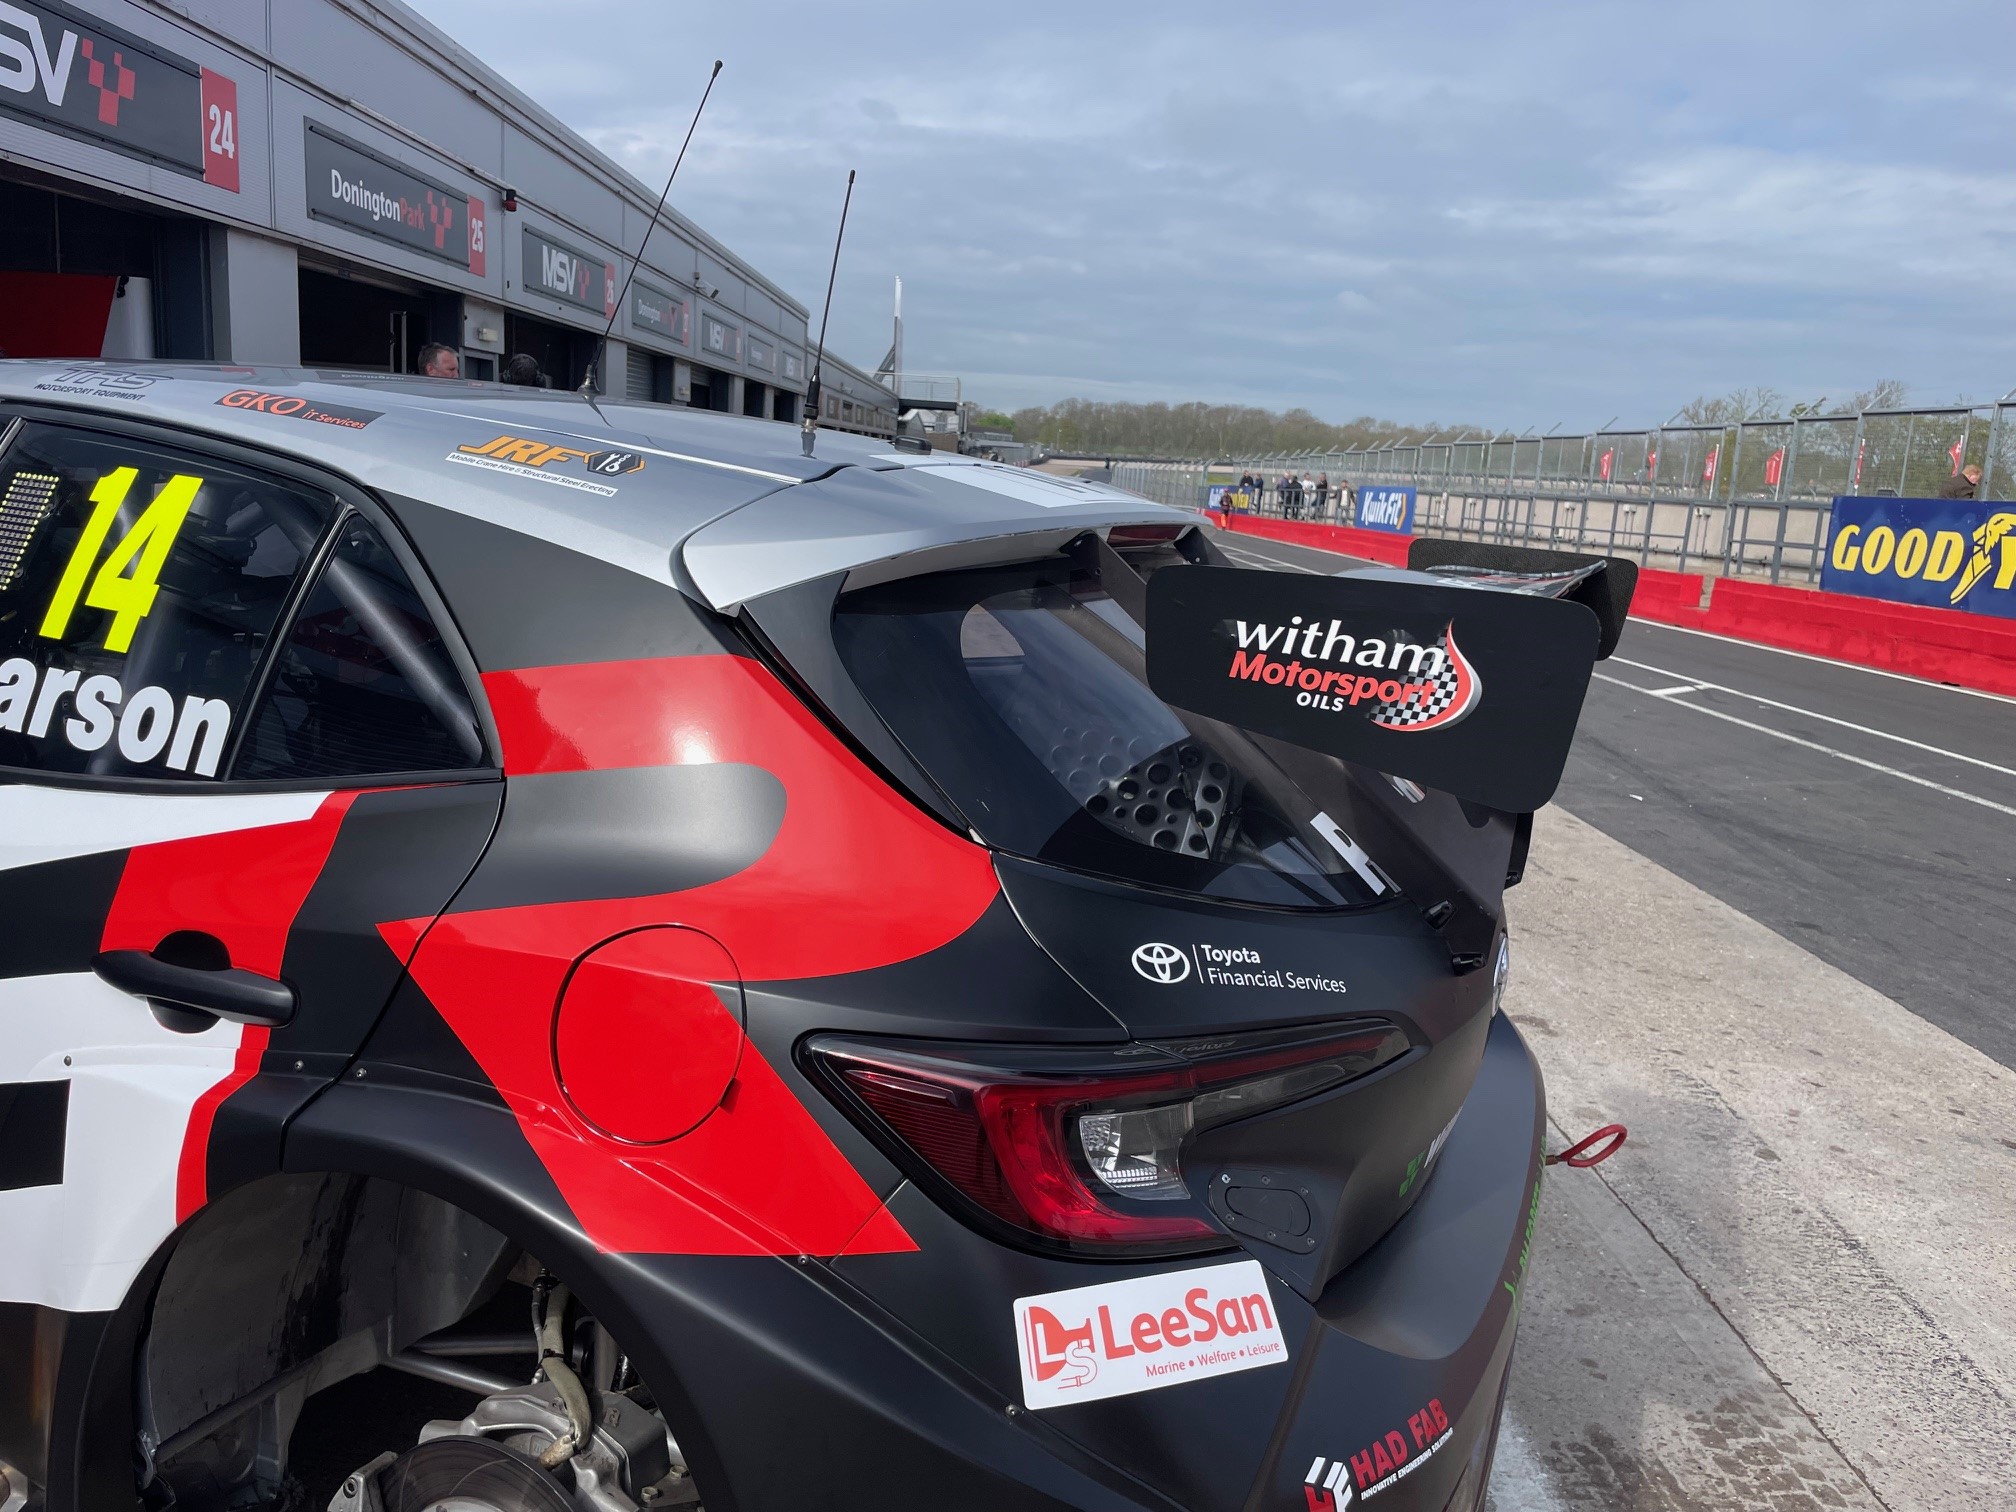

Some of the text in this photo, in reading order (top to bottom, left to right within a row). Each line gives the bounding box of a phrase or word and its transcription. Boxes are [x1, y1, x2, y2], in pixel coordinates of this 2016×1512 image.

[209, 104, 235, 160] 24
[471, 217, 485, 254] 25
[542, 244, 577, 296] MSV
[34, 383, 146, 401] MOTORSPORT EQUIPMENT
[222, 390, 308, 415] GKO
[316, 413, 366, 429] Services
[457, 435, 591, 467] JRF
[449, 453, 476, 464] Mobile
[476, 459, 498, 469] Crane
[497, 464, 515, 473] Hire
[521, 468, 560, 482] Structural
[559, 477, 581, 487] Steel
[580, 483, 614, 496] Erecting
[39, 466, 203, 653] 14
[1236, 616, 1445, 676] witham
[1229, 651, 1437, 707] Motorsport
[1296, 691, 1345, 712] OILS
[1200, 944, 1261, 967] Toyota
[1207, 967, 1347, 993] Financial Services
[1097, 1287, 1274, 1360] LeeSan
[1145, 1341, 1281, 1378] Marine Welfare Leisure
[1350, 1398, 1449, 1489] HAD FAB
[1361, 1472, 1398, 1500] INNOVATIVE
[1397, 1447, 1433, 1479] ENGINEERING
